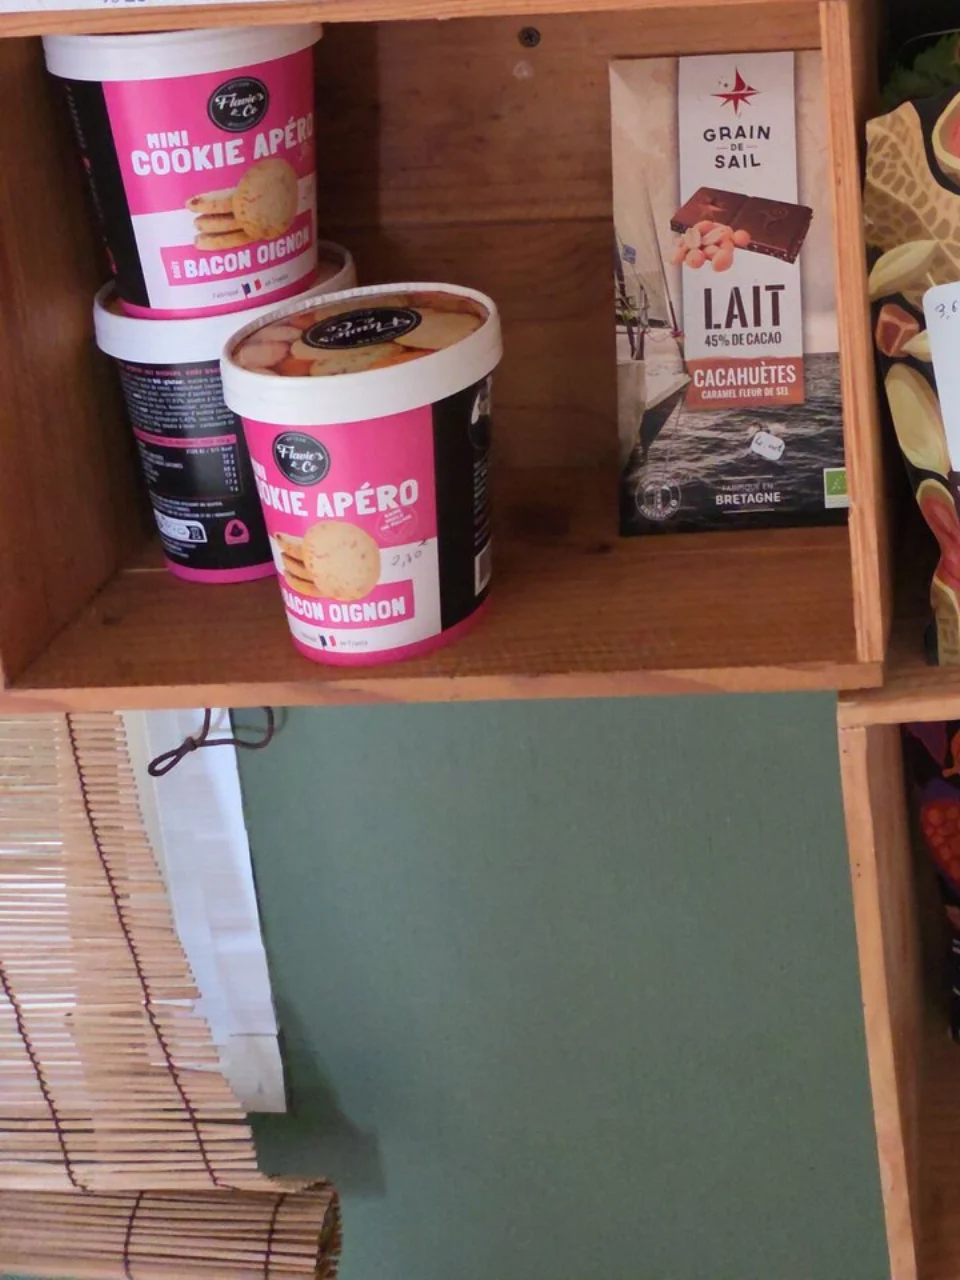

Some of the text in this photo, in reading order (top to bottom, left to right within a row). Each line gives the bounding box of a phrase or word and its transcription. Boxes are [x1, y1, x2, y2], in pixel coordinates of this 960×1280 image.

[146, 130, 189, 149] MINI
[703, 125, 772, 142] GRAIN
[131, 112, 313, 177] COOKIE APÉRO
[730, 142, 744, 152] DE
[714, 154, 761, 169] SAIL
[184, 226, 310, 279] BACON OIGNON
[703, 284, 786, 331] LAIT
[704, 331, 782, 348] 45% DE CACAO
[693, 361, 797, 389] CACAHUÈTES
[701, 386, 790, 400] CARAMEL FLEUR DE SEL
[316, 479, 419, 518] APÉRO
[715, 491, 782, 506] BRETAGNE
[328, 596, 406, 623] OIGNON
